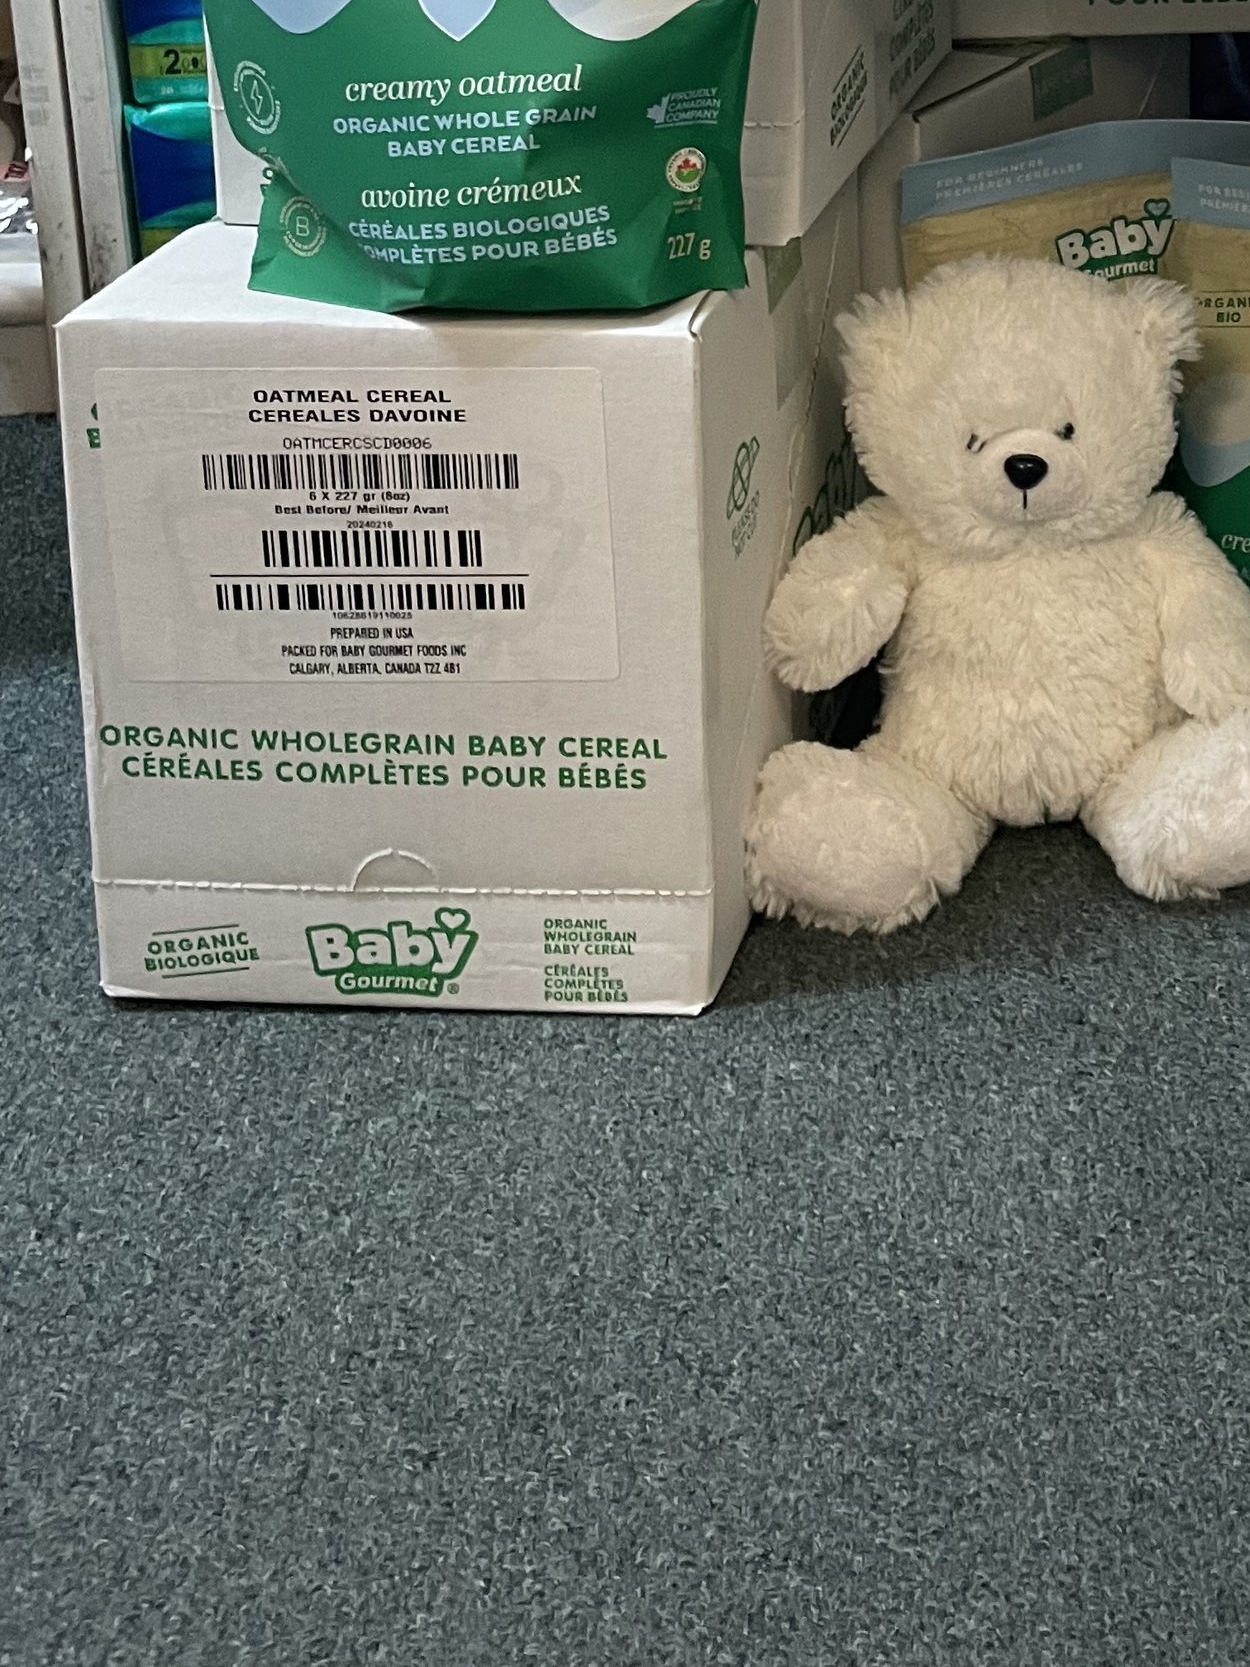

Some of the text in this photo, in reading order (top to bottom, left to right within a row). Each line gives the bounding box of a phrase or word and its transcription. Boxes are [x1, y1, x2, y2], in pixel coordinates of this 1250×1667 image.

[345, 63, 583, 107] creamy oatmeal
[333, 103, 598, 136] ORGANIC WHOLE GRAIN
[387, 134, 541, 158] BABY CEREAL
[360, 171, 582, 210] avoine crémeux
[348, 216, 448, 241] CÉRÉALES
[453, 204, 611, 239] BIOLOGIQUES
[472, 238, 540, 261] POUR
[545, 226, 618, 253] BÉBÉS
[667, 232, 711, 261] 227 g
[252, 389, 452, 403] OATMEAL CEREAL
[248, 408, 467, 422] CEREALES DAVOINE
[282, 437, 433, 450] OATMCERCSCD0006
[274, 504, 450, 515] Best Before/ Meilleur Avant
[309, 490, 411, 503] 6 X 227 gr (8oz)
[100, 725, 668, 762] ORGANIC WHOLEGRAIN BABY CEREAL
[121, 752, 648, 791] CÉRÉALES COMPLÈTES POUR BÉBÉS
[147, 931, 250, 956] ORGANIC
[305, 921, 480, 977] Baby
[144, 947, 260, 972] BIOLOGIQUE
[339, 971, 440, 994] Gourmet
